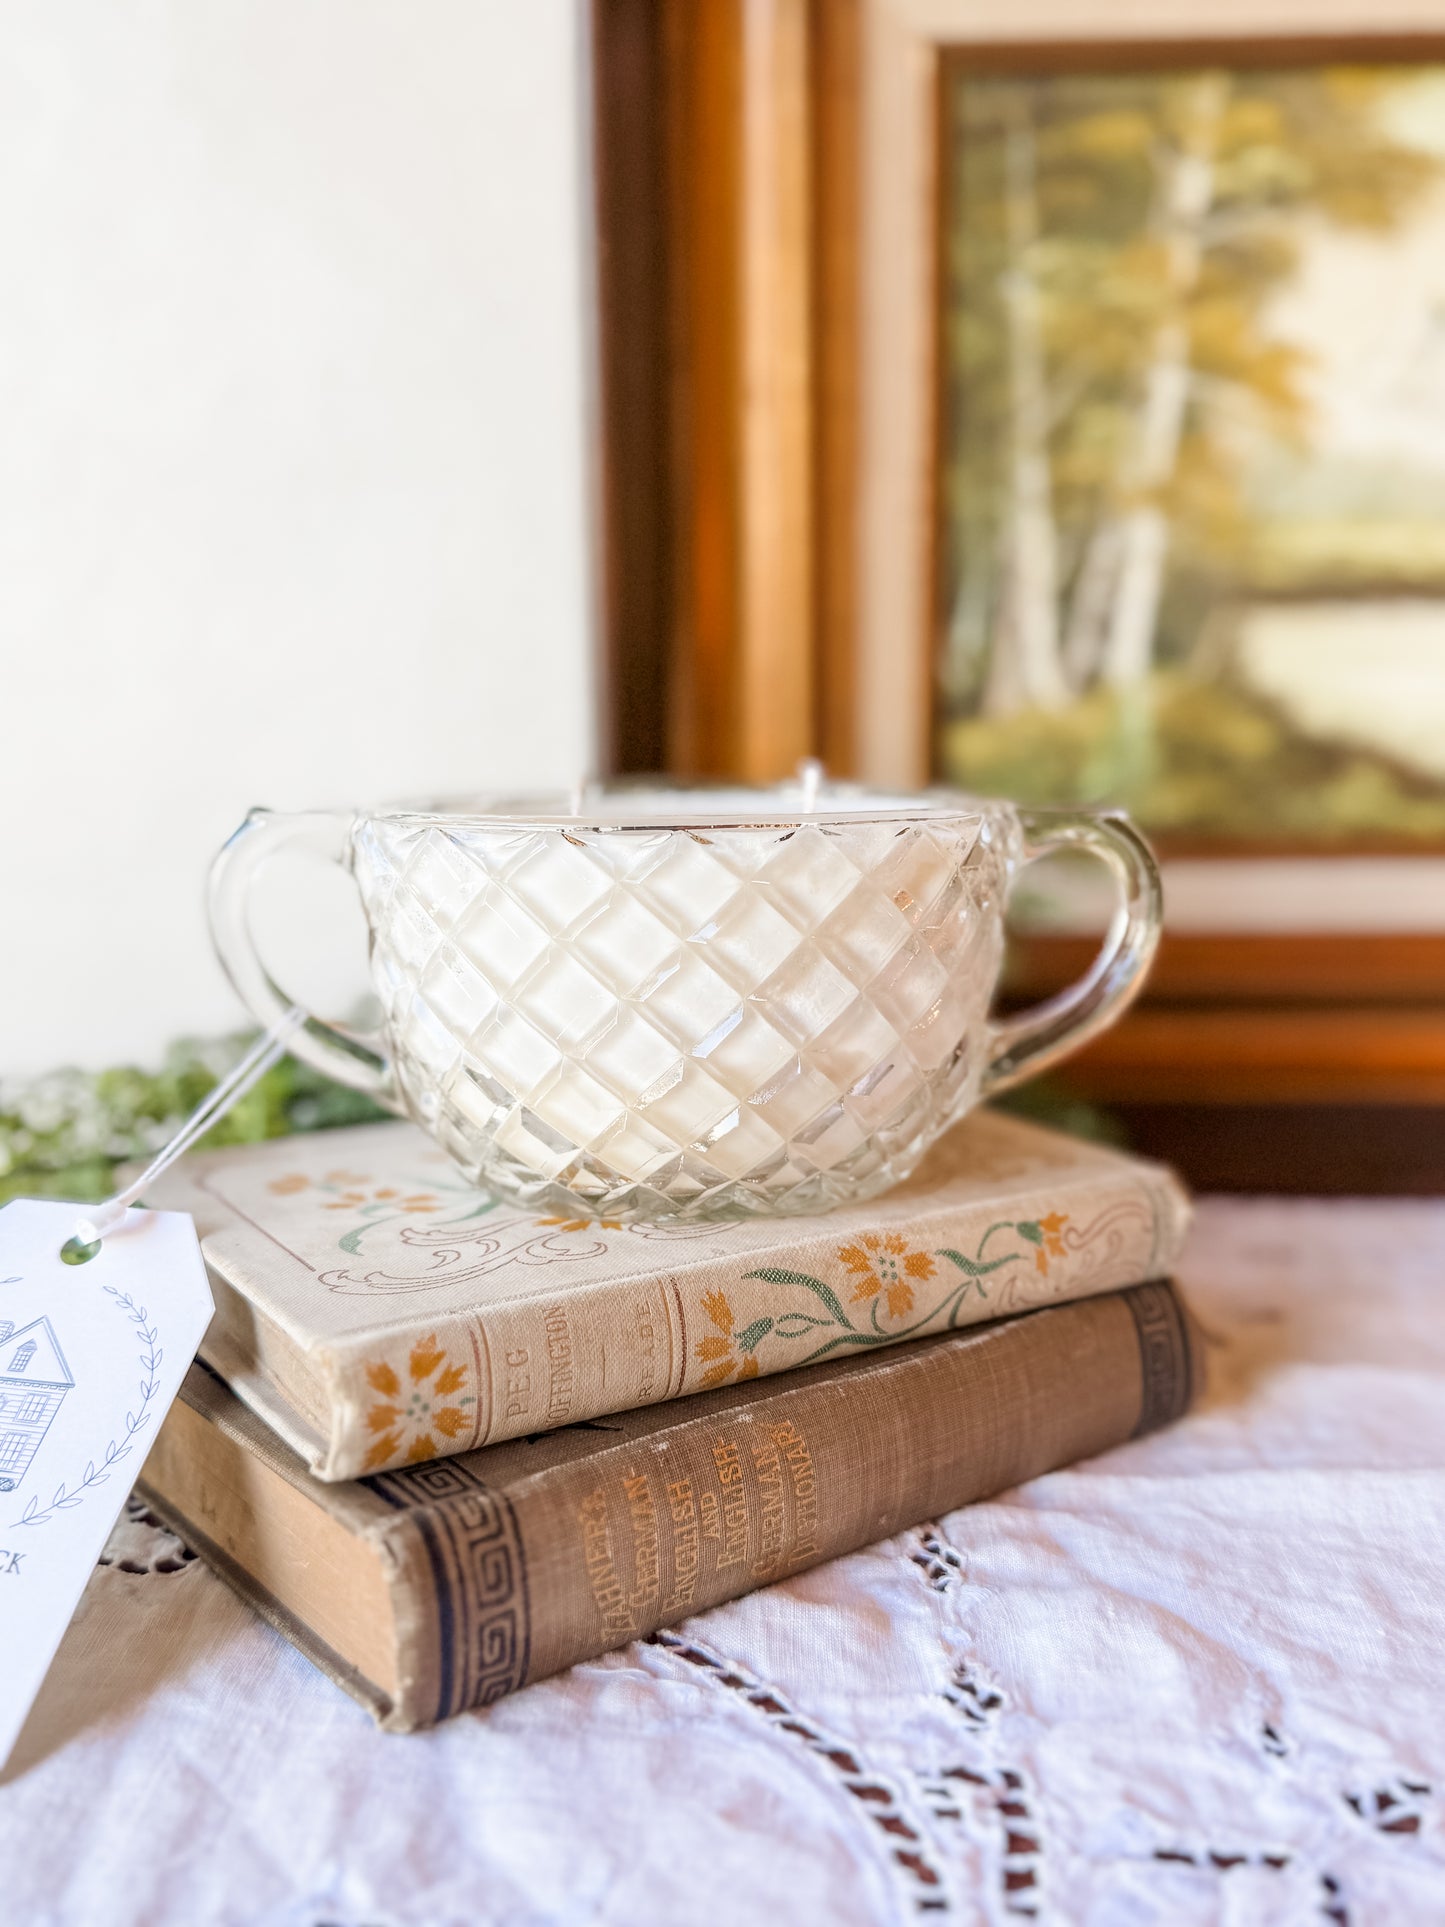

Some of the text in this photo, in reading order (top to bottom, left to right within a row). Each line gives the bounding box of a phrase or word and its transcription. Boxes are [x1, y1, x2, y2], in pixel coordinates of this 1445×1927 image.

[506, 1349, 531, 1418] PEG
[700, 1492, 721, 1540] AND
[758, 1421, 820, 1567] DICTIONARY
[661, 1479, 698, 1614] ENGLISH
